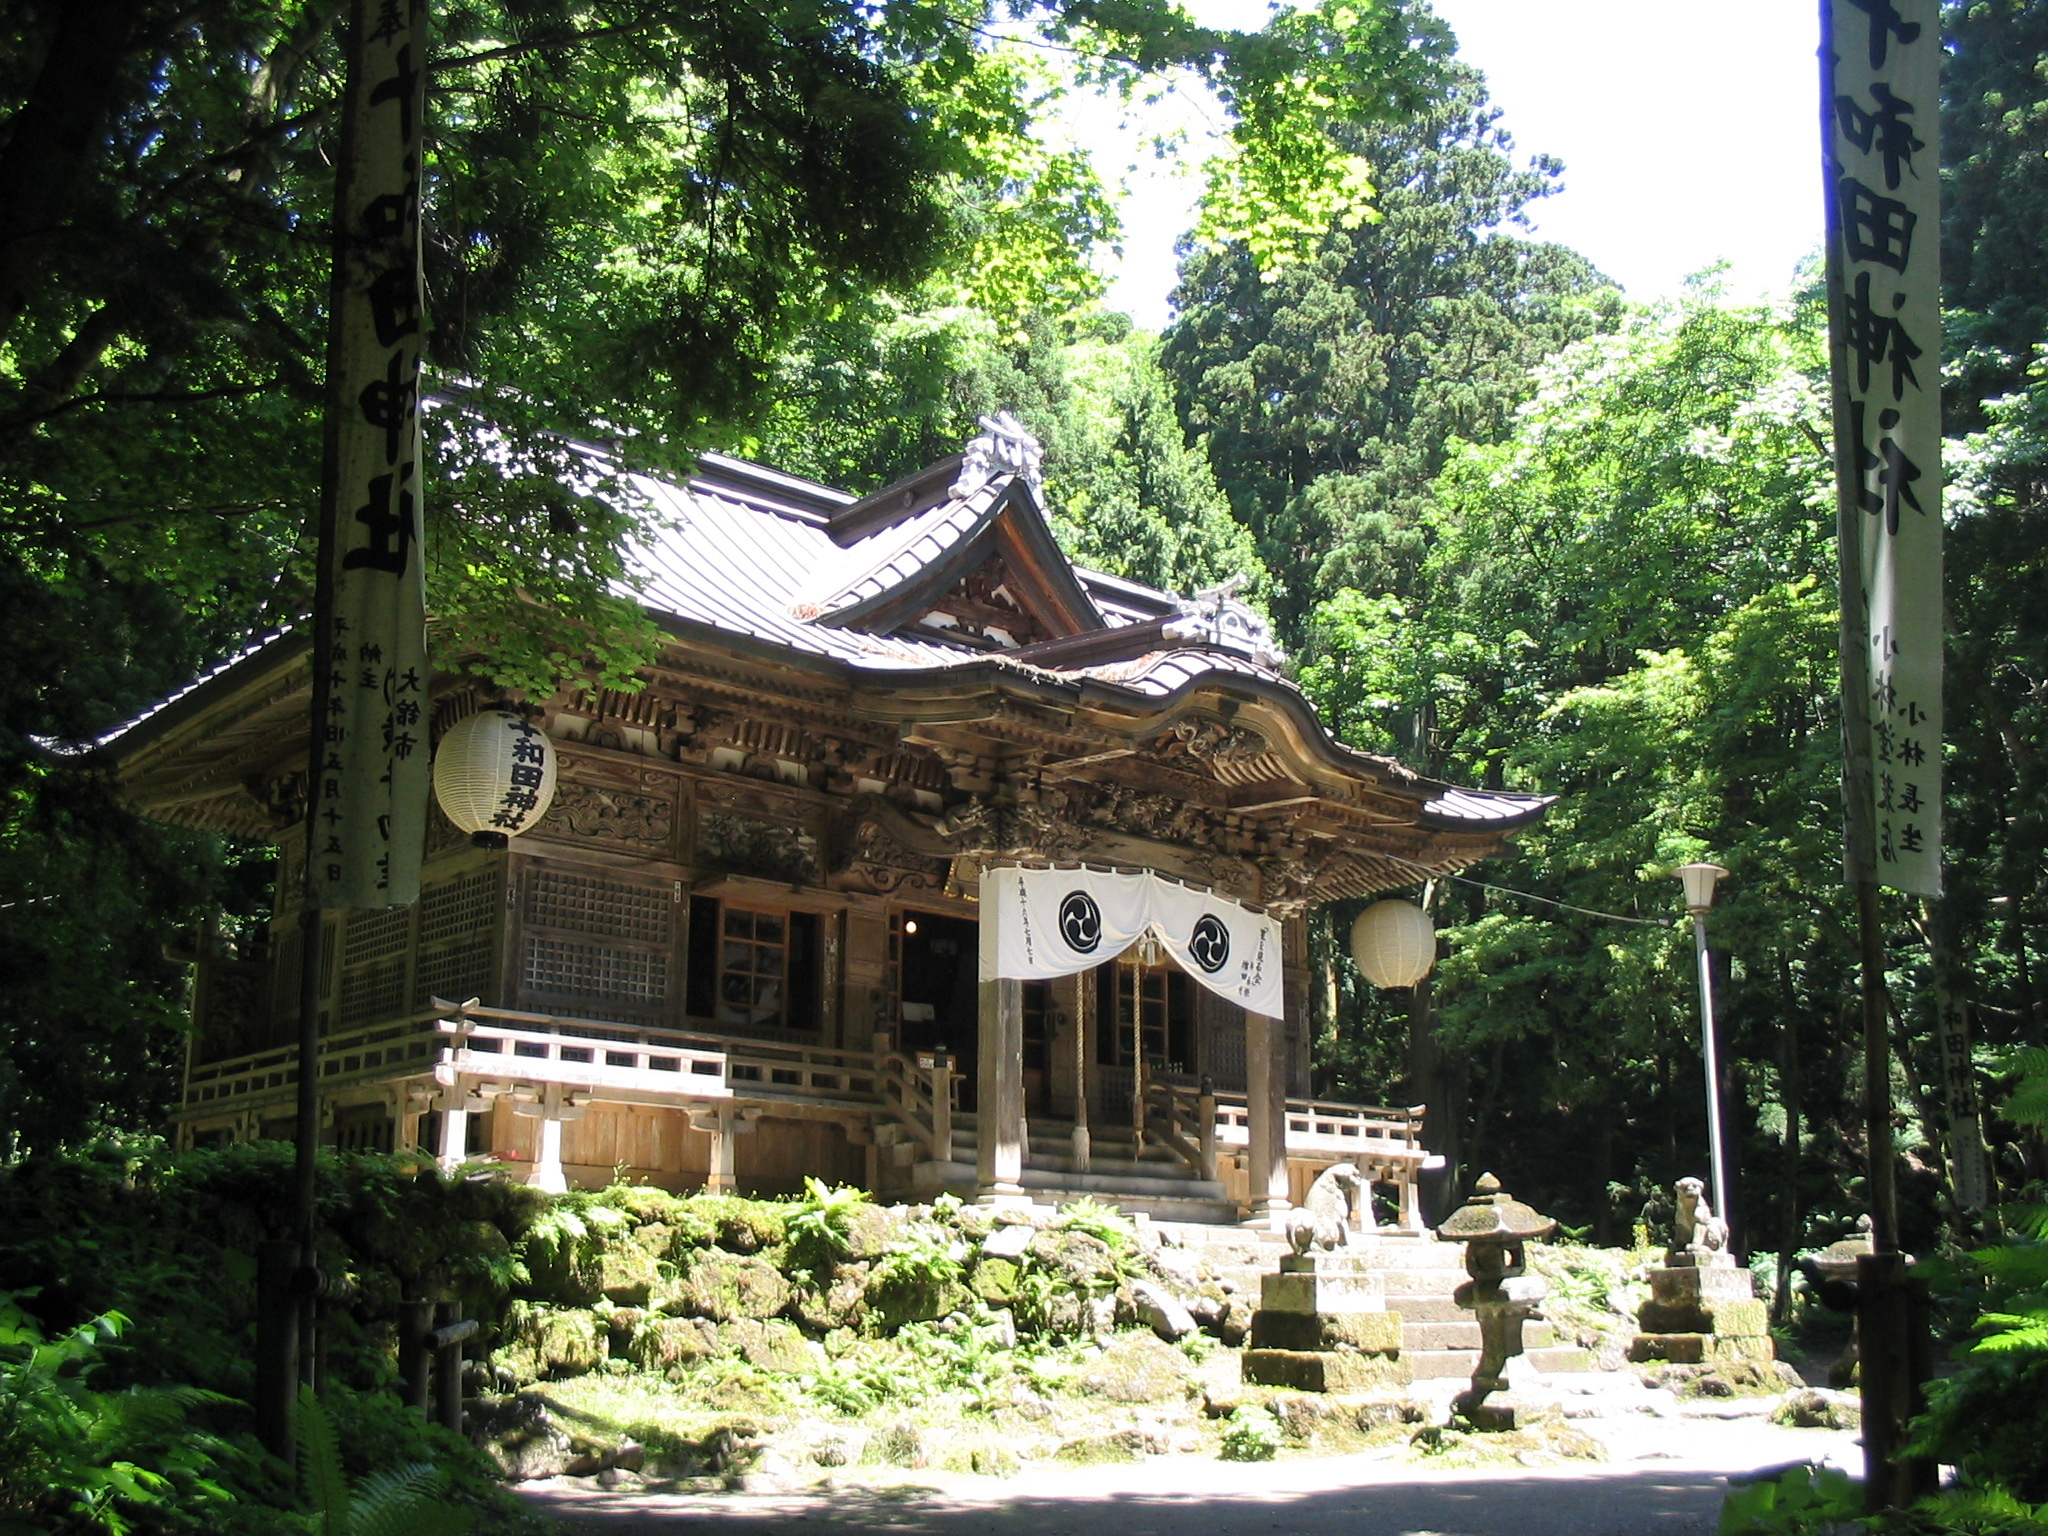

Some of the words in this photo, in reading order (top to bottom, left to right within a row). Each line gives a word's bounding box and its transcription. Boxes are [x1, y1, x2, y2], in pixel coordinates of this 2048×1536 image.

[488, 721, 545, 830] 十和田神社
